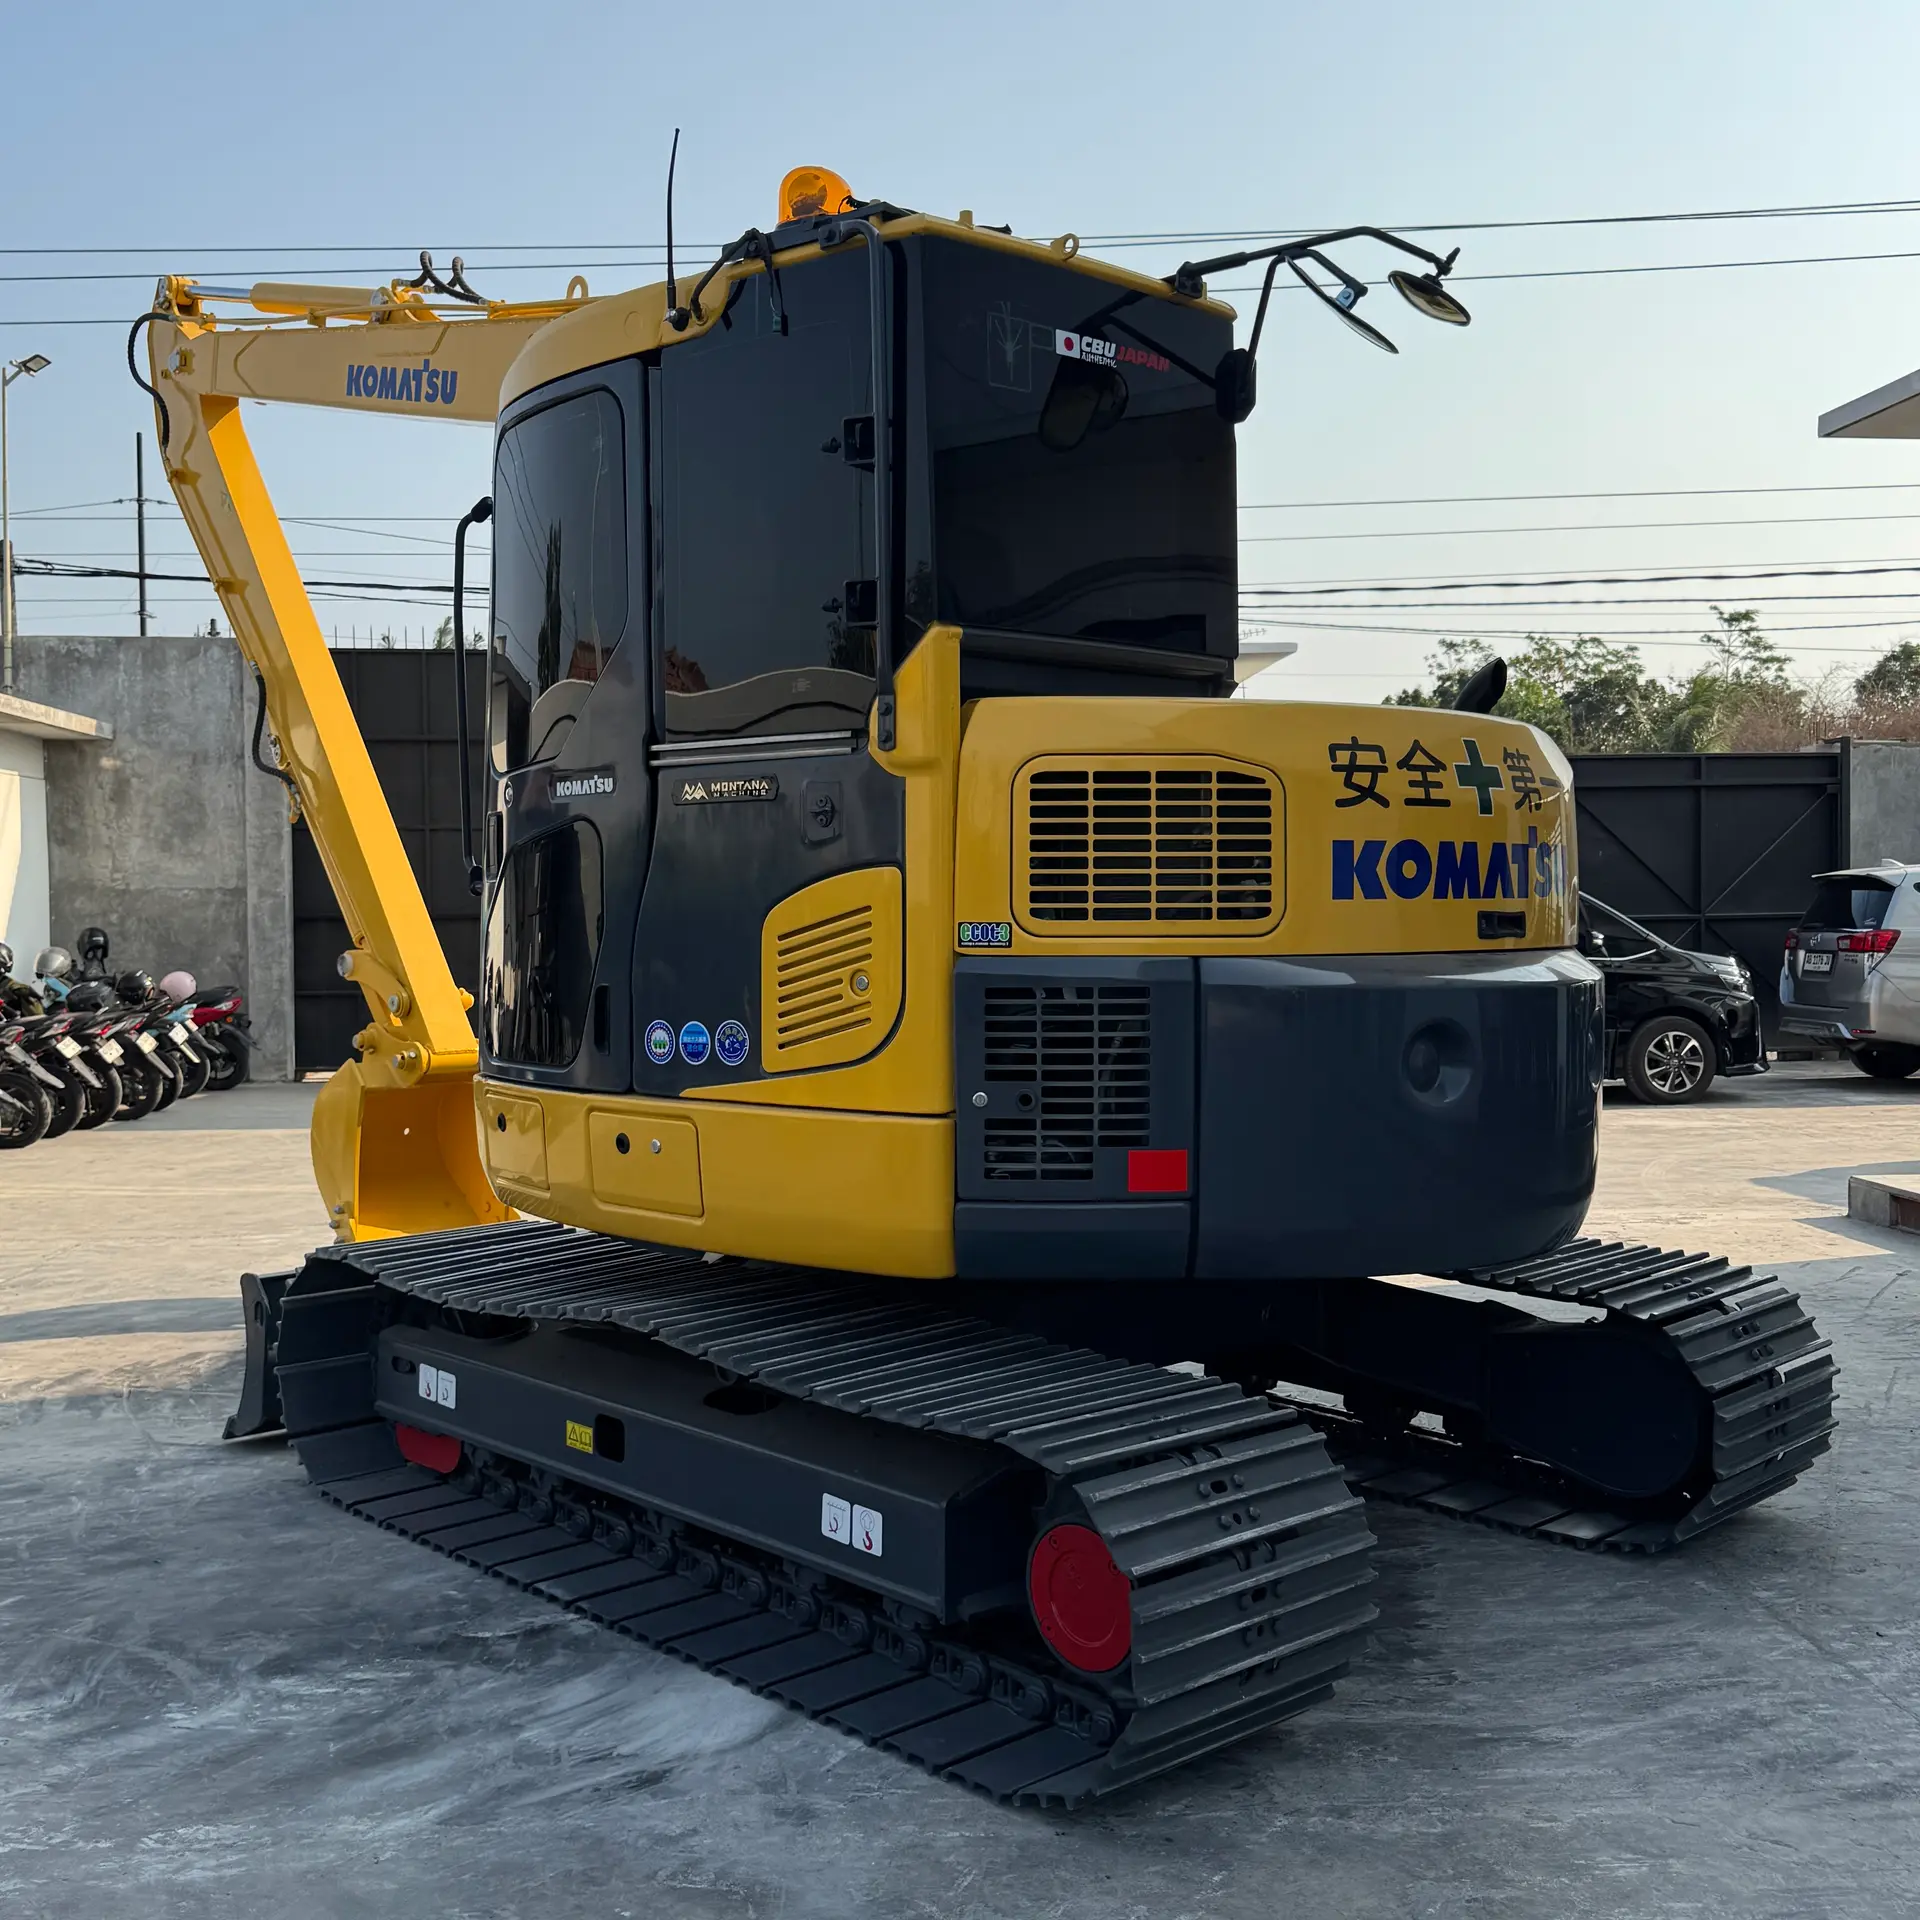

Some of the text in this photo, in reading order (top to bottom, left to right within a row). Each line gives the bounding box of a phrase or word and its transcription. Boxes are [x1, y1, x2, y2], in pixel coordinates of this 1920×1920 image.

[1081, 336, 1170, 372] CBU JAPAN
[346, 358, 459, 405] KOMATSU
[556, 774, 613, 797] KOMATSU
[711, 780, 769, 792] MONTANA
[1328, 735, 1562, 814] 安全 第一
[713, 789, 767, 798] MACHINE
[1331, 825, 1569, 901] KOMATSU
